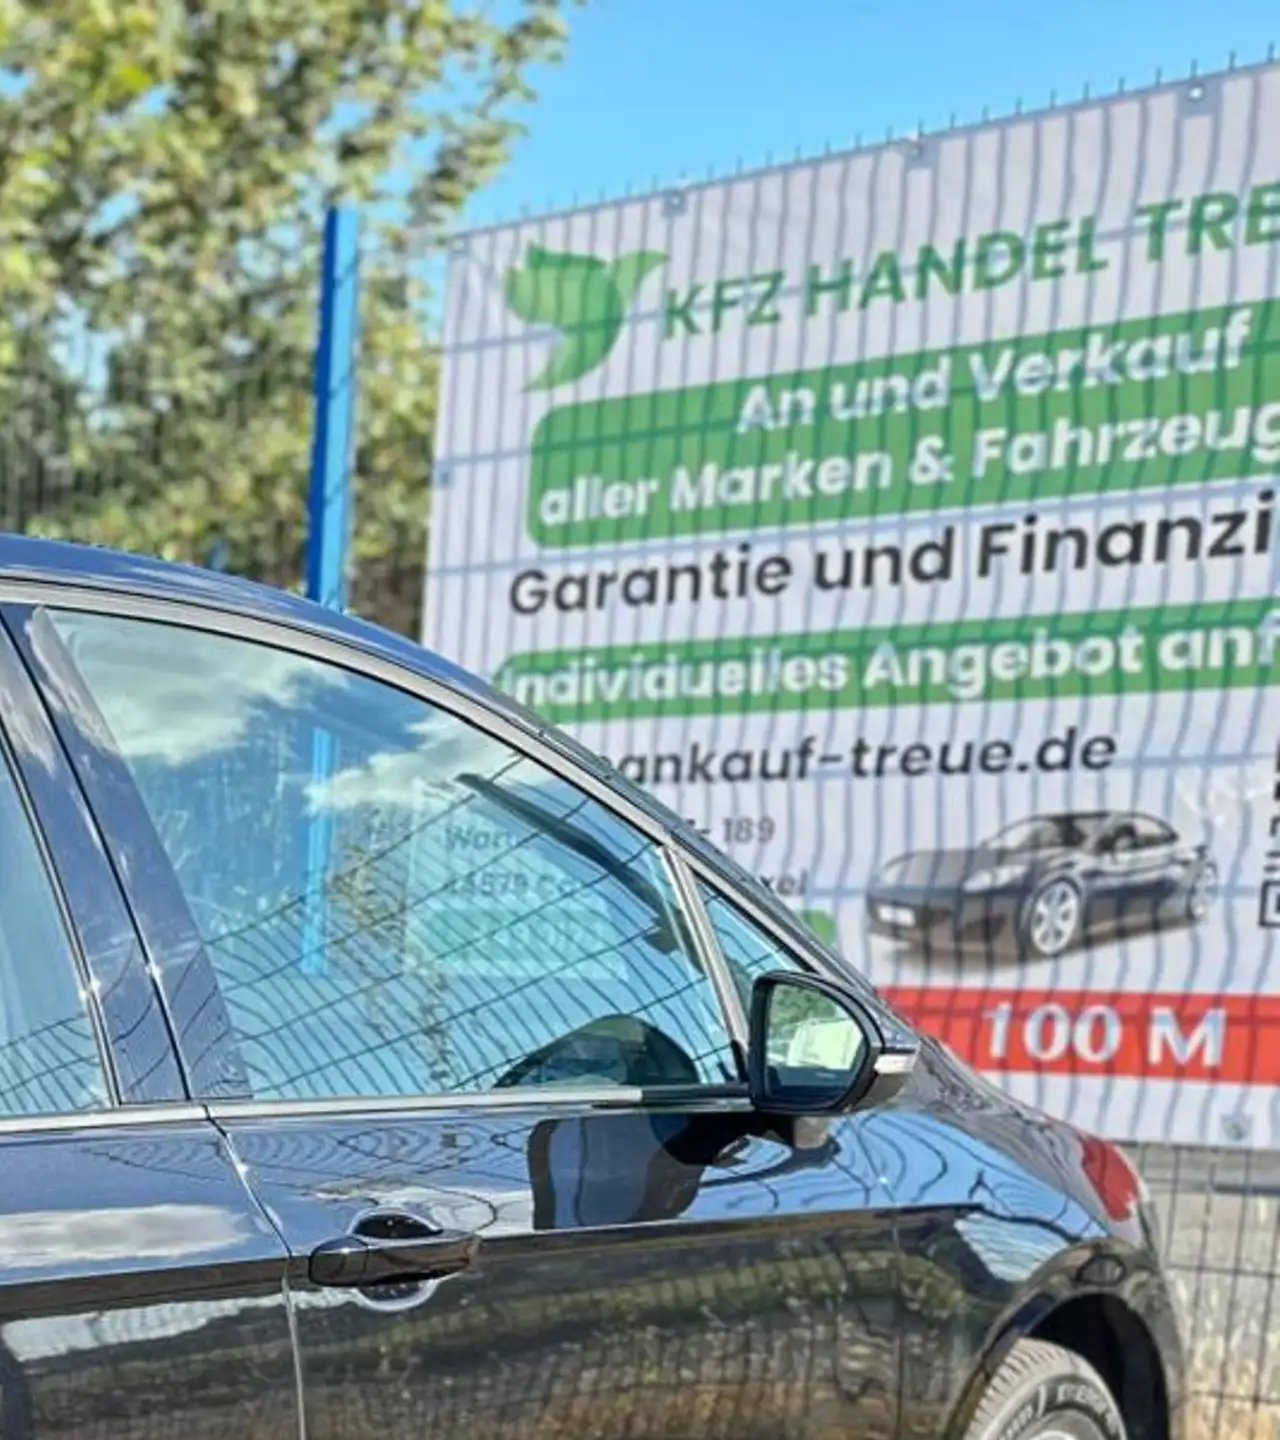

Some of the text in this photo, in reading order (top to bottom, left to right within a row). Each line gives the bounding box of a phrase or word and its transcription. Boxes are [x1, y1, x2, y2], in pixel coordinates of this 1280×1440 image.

[663, 180, 1280, 340] KFZ HANDEL TRE
[737, 307, 1253, 434] An und Verkauf
[539, 402, 1280, 527] aller Marken & Fahrzeug
[508, 488, 1276, 615] Garantie und Finanzi
[504, 648, 849, 708] Individuelles
[863, 625, 1146, 699] Angebot
[616, 725, 1118, 786] ankauf-treue.de
[721, 814, 777, 846] 189
[983, 1001, 1228, 1068] 100 M
